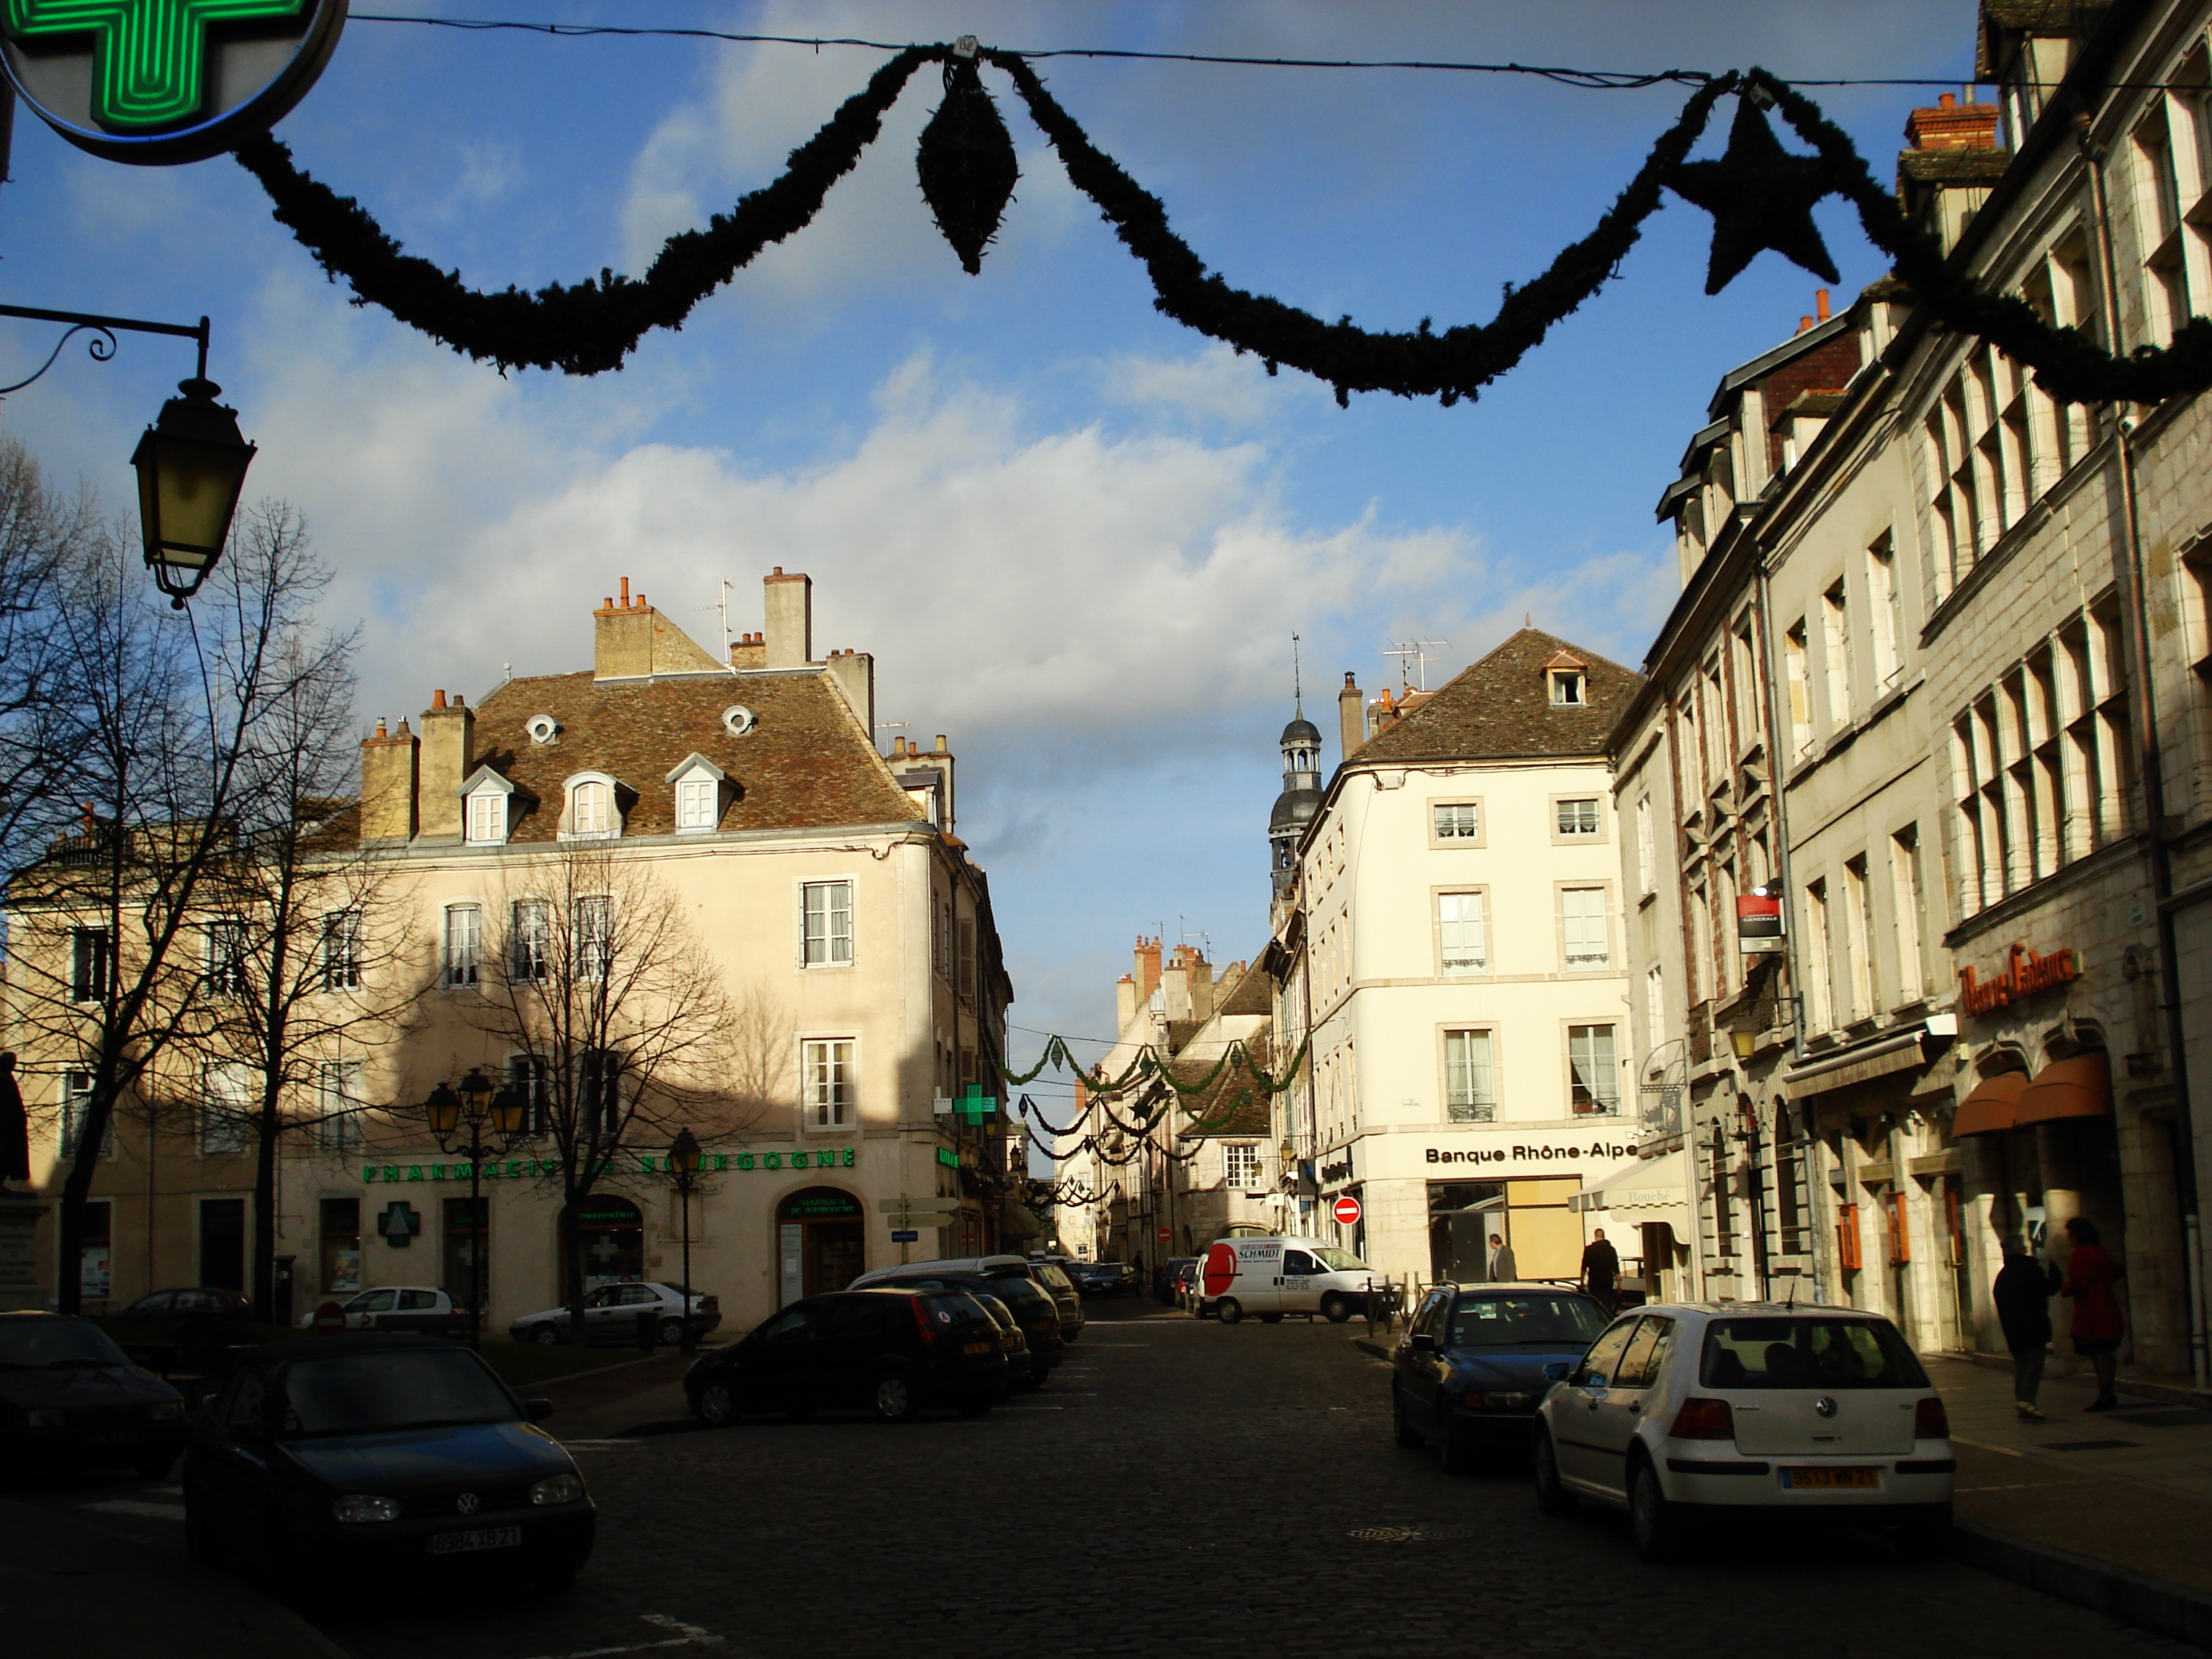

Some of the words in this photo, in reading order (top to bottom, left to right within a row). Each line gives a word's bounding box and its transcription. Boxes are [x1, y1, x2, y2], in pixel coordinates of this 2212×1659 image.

[1426, 1148, 1506, 1165] Banque
[1512, 1142, 1638, 1161] Rhône-Alpe
[364, 1159, 554, 1182] PHARMACIE
[1629, 1190, 1671, 1202] Bouché
[805, 1205, 855, 1214] BOURGOGNE
[1238, 1249, 1280, 1259] SCHMIDT
[1794, 1469, 1830, 1485] 9513
[1856, 1469, 1874, 1485] 21
[436, 1533, 473, 1551] 8984
[477, 1530, 495, 1547] XB
[500, 1529, 516, 1545] 21
